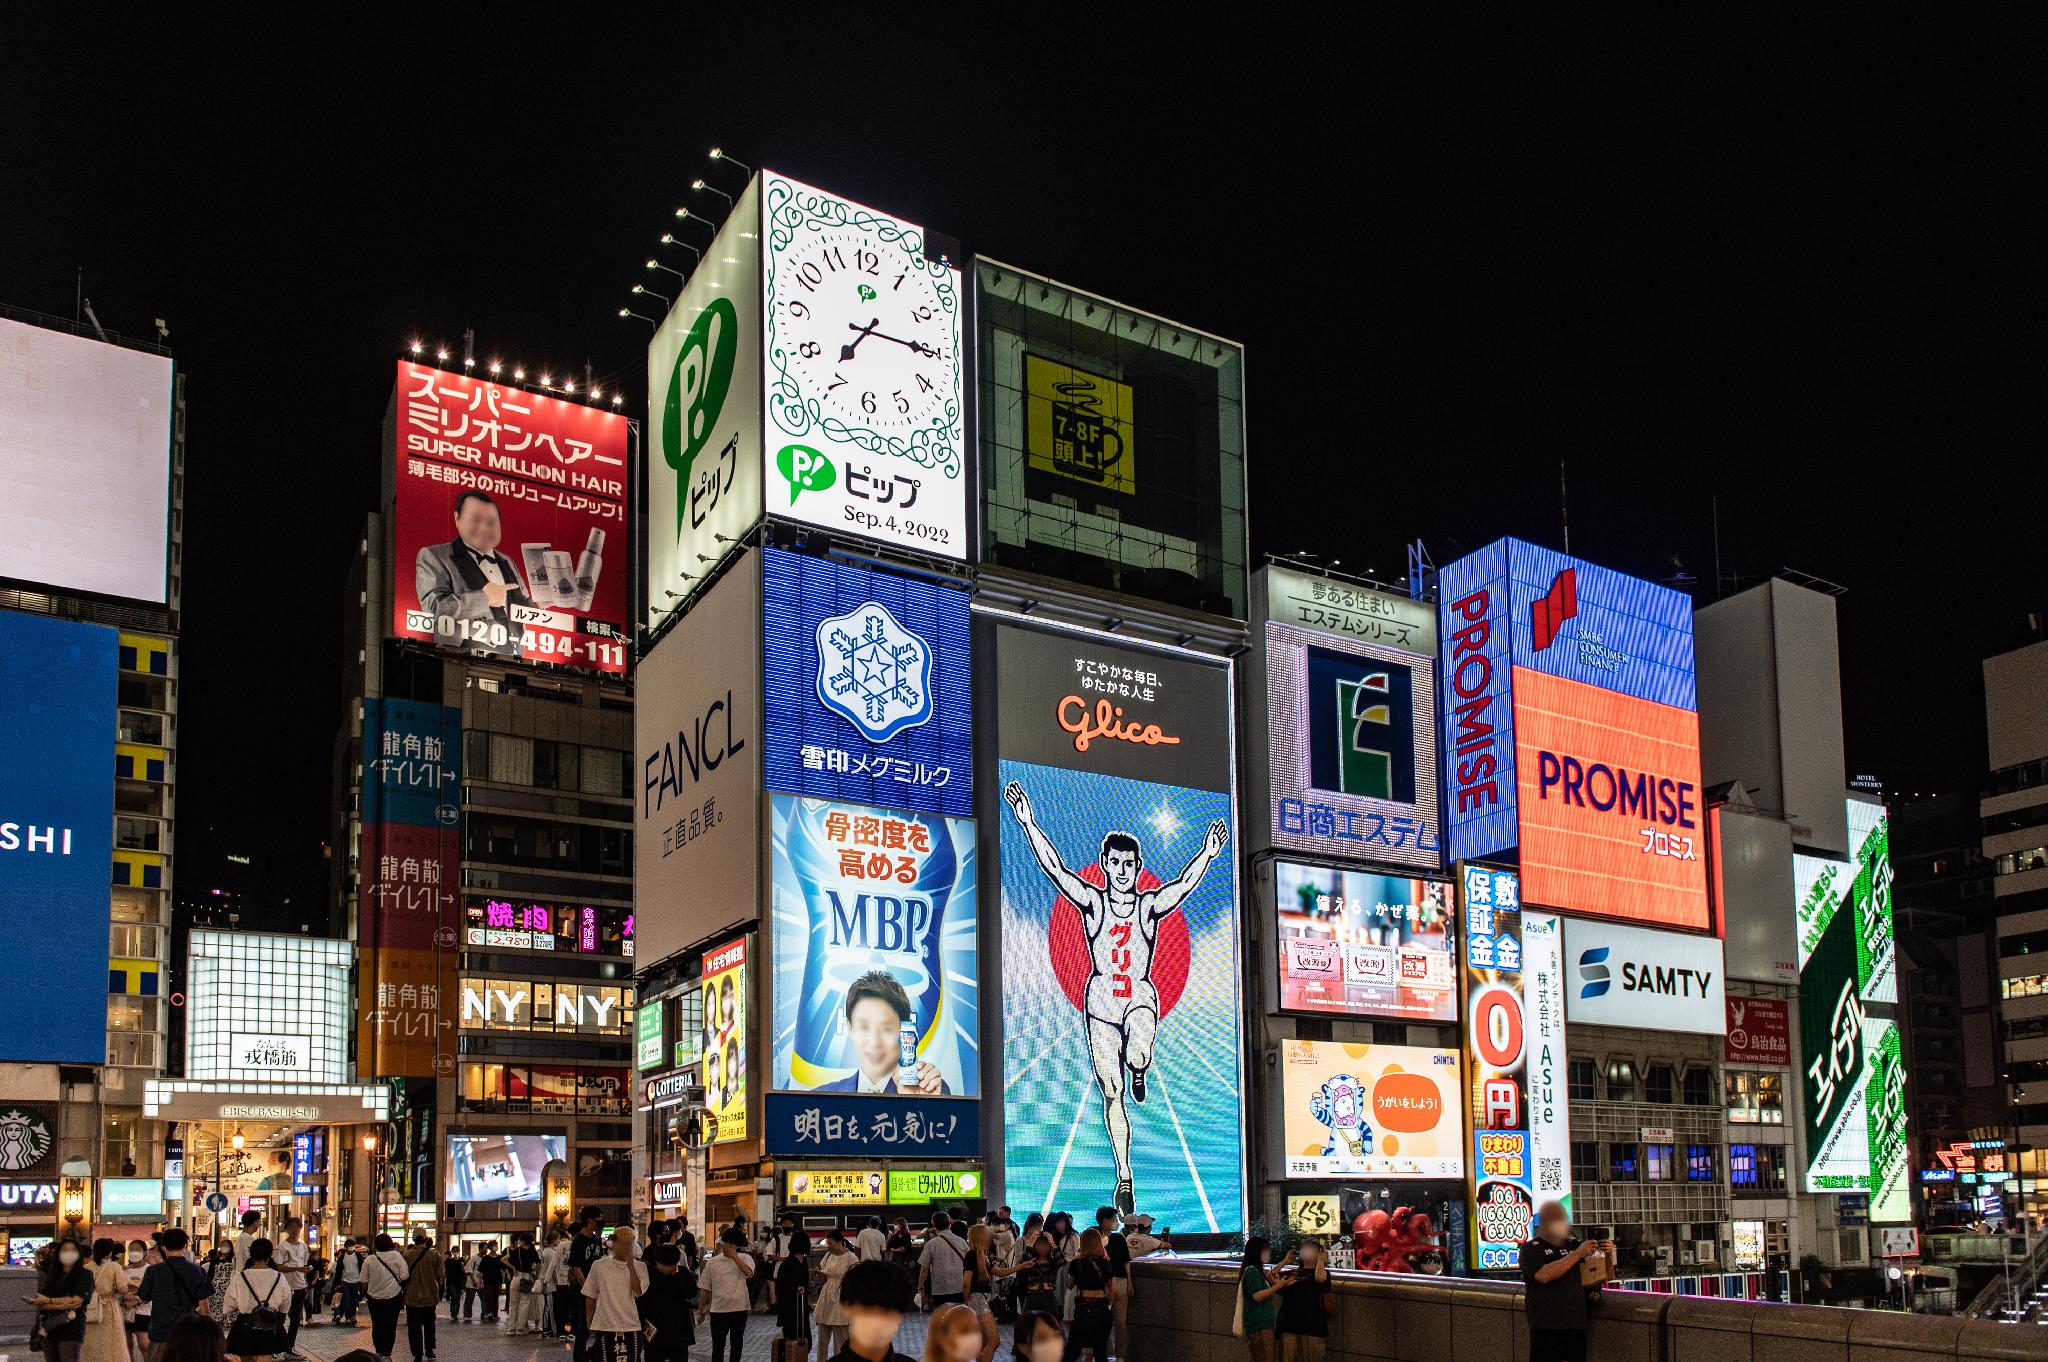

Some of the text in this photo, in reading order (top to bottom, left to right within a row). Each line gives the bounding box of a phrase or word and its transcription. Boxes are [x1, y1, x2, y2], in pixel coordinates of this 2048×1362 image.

[822, 246, 847, 273] 11
[854, 248, 879, 277] 12
[796, 262, 822, 293] 10
[893, 274, 905, 291] 1
[789, 300, 811, 320] 9
[911, 306, 932, 323] 2
[799, 341, 821, 359] 8
[409, 370, 531, 418] スーパー
[828, 372, 848, 391] 7
[915, 373, 933, 393] 4
[861, 391, 877, 414] 6
[893, 390, 910, 414] 5
[409, 401, 623, 466] ミリオンヘアー
[408, 434, 623, 497] SUPER MILLION HAIR
[691, 432, 739, 530] ピップ
[846, 462, 921, 509] ピップ
[844, 505, 950, 545] Sep. 4, 2022
[1312, 582, 1396, 615] 夢ある住まい
[514, 608, 553, 624] ルアン
[586, 620, 611, 637] 検索
[1298, 607, 1410, 646] エステムシリーズ
[437, 615, 623, 666] 0120-494-111
[1578, 629, 1604, 645] SMBC
[1579, 641, 1628, 664] CONSUMER
[1580, 652, 1619, 673] FINANCE
[1074, 658, 1162, 687] すこやかな毎日、
[1082, 676, 1155, 701] ゆたかな人生
[1452, 589, 1498, 813] PROMISE
[1057, 695, 1180, 752] Glico
[382, 730, 446, 762] 龍角散
[645, 689, 745, 820] FANCL
[370, 759, 440, 789] ダイレクト
[800, 745, 951, 787] 雪印メグミルク
[1856, 774, 1876, 782] HOTEL
[1538, 751, 1695, 829] PROMISE
[1850, 780, 1883, 788] MONTEREY
[663, 795, 723, 859] 正直品質。
[825, 811, 930, 853] 骨密度を
[1281, 797, 1440, 850] 日商エステム
[0, 822, 72, 855] SHI
[1641, 827, 1697, 860] プロミス
[381, 855, 443, 884] 龍角散
[837, 848, 918, 884] 高める
[368, 882, 439, 912] ダイレクト
[1316, 895, 1427, 922] 備える、かぜ薬。
[487, 901, 547, 931] 焼肉
[825, 887, 930, 953] MBP
[1468, 871, 1494, 967] 保証金
[1493, 874, 1520, 969] 敷金
[1526, 921, 1548, 934] Asue
[1108, 921, 1133, 998] グリコ
[1623, 962, 1711, 999] SAMTY
[378, 982, 441, 1010] 龍角散
[464, 988, 526, 1022] NY
[558, 993, 616, 1026] NY
[365, 1011, 437, 1038] ダイレクト
[244, 1050, 297, 1066] 戎橋筋
[256, 1039, 286, 1049] なんば
[1538, 971, 1553, 1124] 株式会社 Asue
[1808, 977, 1866, 1128] エイブル
[1433, 1055, 1456, 1065] CHINTAI
[655, 1073, 693, 1097] LOTTERIA
[1871, 1054, 1907, 1145] エイブル
[1378, 1095, 1438, 1110] うがいをしよう!
[1481, 1135, 1523, 1154] ひまわり
[1484, 1157, 1522, 1176] 不動産
[919, 1174, 956, 1194] ピタットハウス
[1494, 1189, 1513, 1204] 06
[1481, 1205, 1528, 1222] (6641)
[1487, 1223, 1524, 1240] 6304
